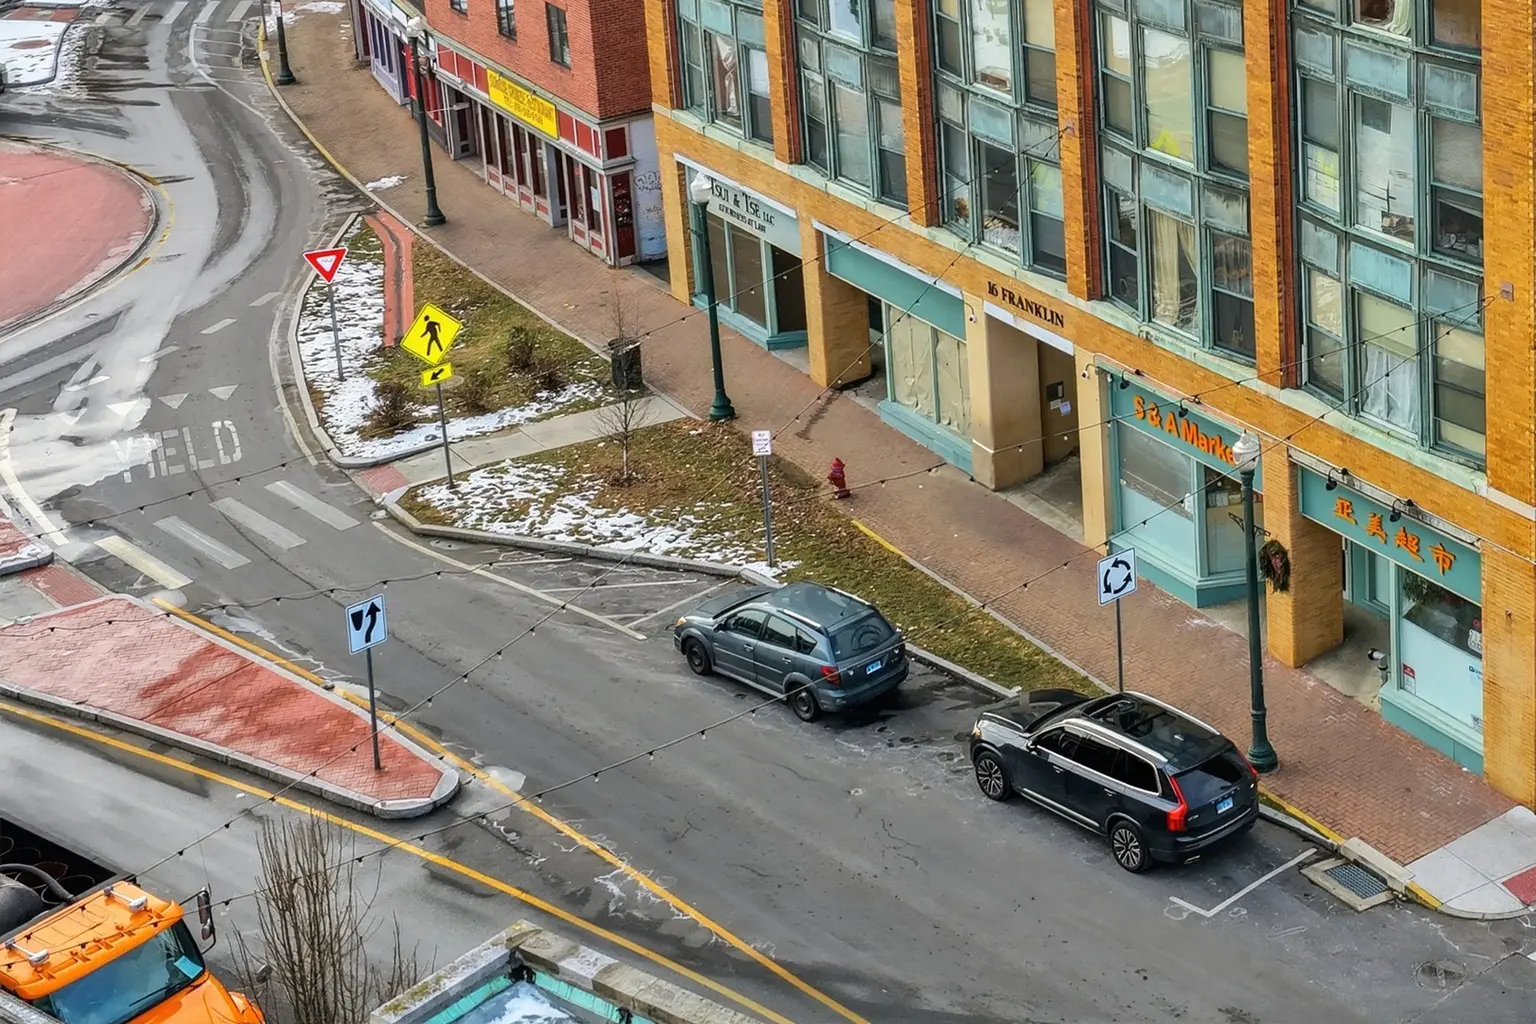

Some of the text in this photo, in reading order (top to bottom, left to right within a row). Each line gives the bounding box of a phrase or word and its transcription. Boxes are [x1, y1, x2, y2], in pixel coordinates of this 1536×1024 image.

[733, 193, 740, 208] &
[987, 281, 1065, 328] 16 FRANKLIN
[110, 420, 242, 483] YIELD
[1133, 395, 1236, 467] S & A Marke
